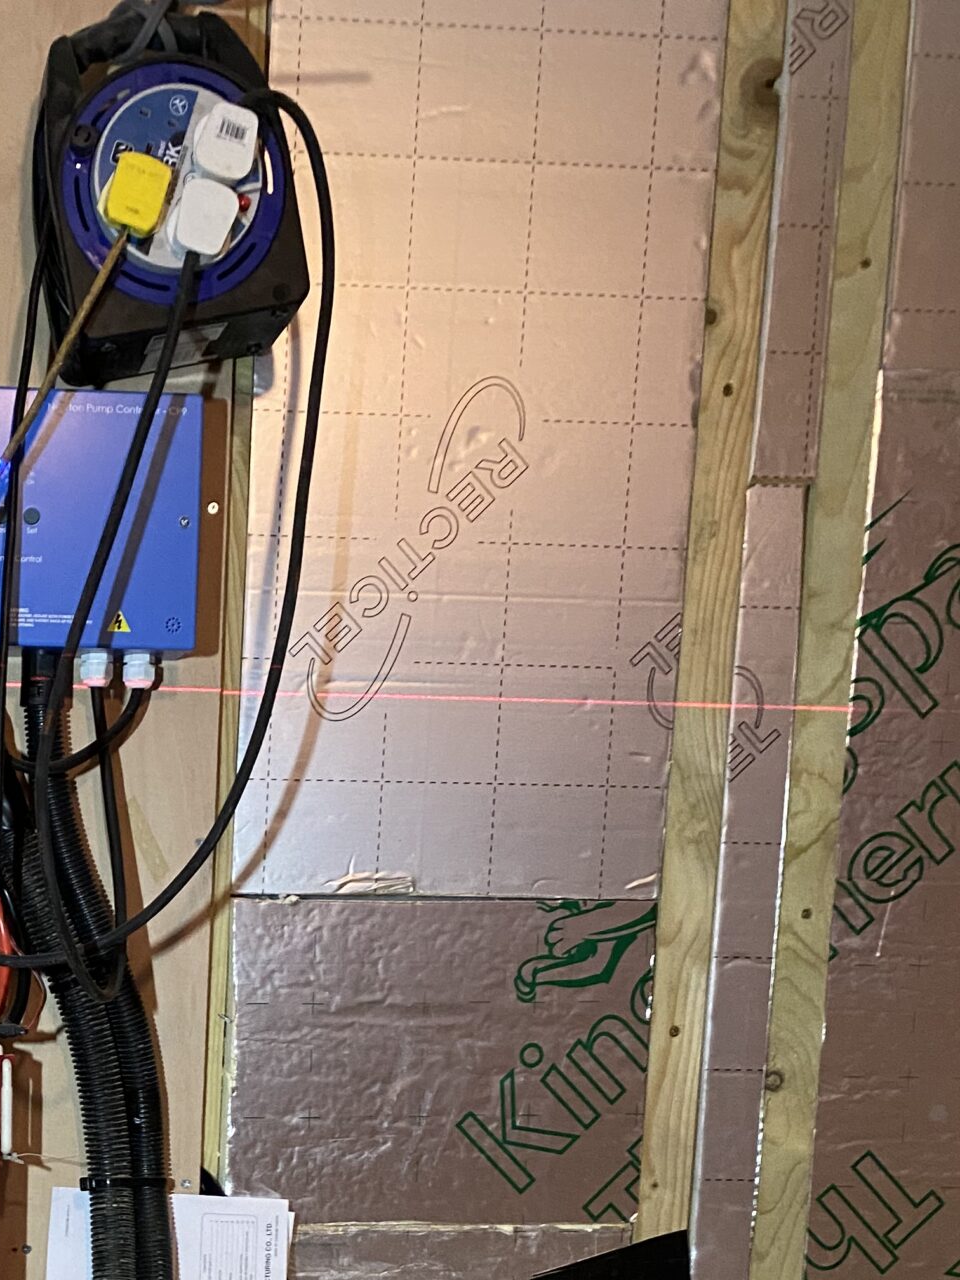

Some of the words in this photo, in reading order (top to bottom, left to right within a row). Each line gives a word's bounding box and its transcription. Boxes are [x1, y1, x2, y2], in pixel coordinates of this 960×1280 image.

[86, 403, 114, 415] Pump
[26, 526, 38, 534] Set
[456, 968, 654, 1194] Kin
